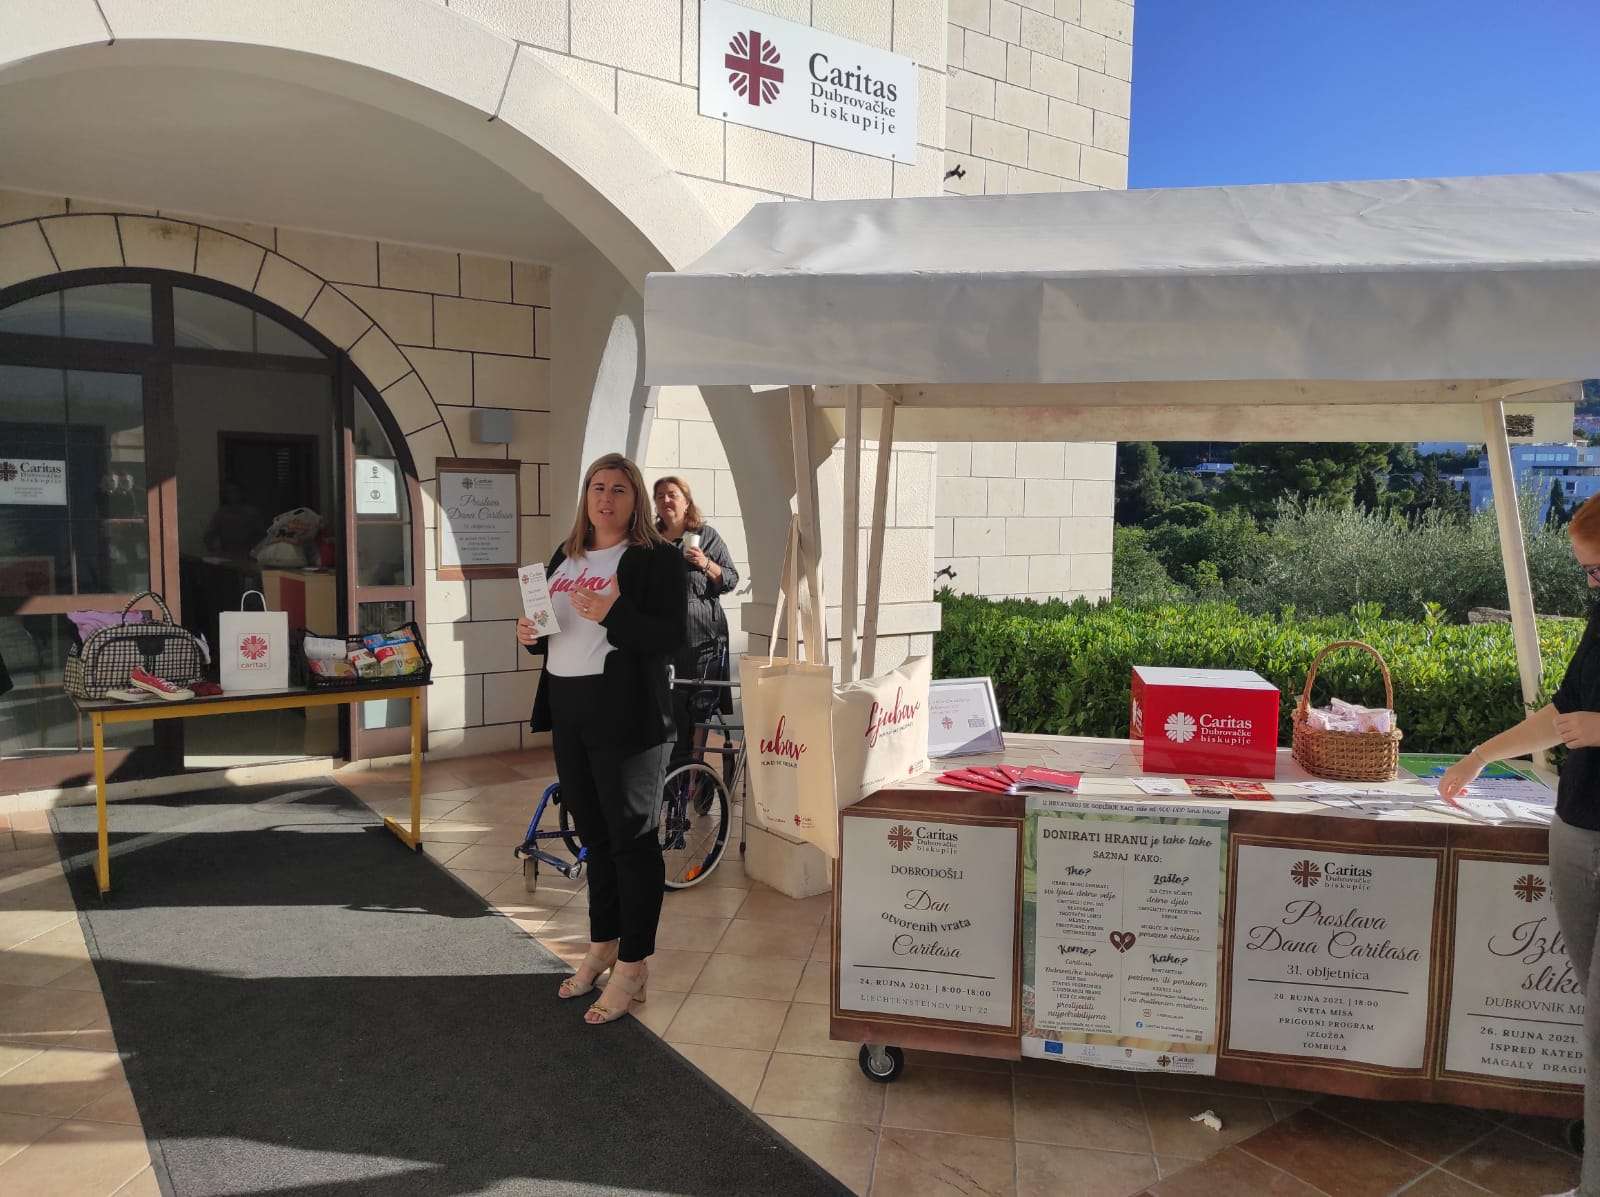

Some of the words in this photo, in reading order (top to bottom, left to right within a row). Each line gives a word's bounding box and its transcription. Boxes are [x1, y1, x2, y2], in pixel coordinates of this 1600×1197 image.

[808, 52, 898, 103] Caritas
[810, 82, 896, 118] Dubrovačke
[810, 99, 896, 135] biskupije
[20, 462, 62, 473] Caritas
[864, 686, 921, 748] Ljubav
[1199, 713, 1252, 729] Caritas
[1201, 727, 1251, 737] Dubrovačke
[1200, 736, 1251, 746] biskupije
[916, 826, 959, 842] Caritas
[1043, 829, 1101, 844] DONIRATI
[1104, 834, 1148, 846] HRANU
[1149, 834, 1160, 849] je
[1093, 850, 1129, 861] SAZNAJ
[1134, 853, 1163, 863] KAKO:
[890, 864, 964, 880] DOBRODOŠLI
[1324, 862, 1373, 878] Caritas
[1153, 873, 1190, 886] Zašto?
[903, 888, 951, 913] Dan
[881, 911, 938, 933] otvorenih
[940, 918, 972, 932] vrata
[1281, 899, 1389, 930] Proslava
[892, 934, 961, 959] Caritasa
[1245, 925, 1320, 953] Dana
[1327, 929, 1422, 962] Caritasa
[1149, 953, 1188, 967] Kako?
[1286, 964, 1302, 977] 31.
[1306, 966, 1370, 981] obljetnica
[859, 977, 872, 986] 24.
[876, 978, 906, 989] RUJNA
[860, 994, 951, 1010] LIECHTENSTEINOV
[955, 1003, 974, 1013] PUT
[1290, 993, 1320, 1004] RUJNA
[1484, 996, 1564, 1014] DUBROVNIK
[1297, 1006, 1326, 1016] SVETA
[1330, 1008, 1354, 1018] MISA
[1279, 1017, 1325, 1028] PRIGODNI
[1328, 1020, 1375, 1031] PROGRAM
[1305, 1030, 1345, 1040] IZLOŽBA
[1479, 1025, 1497, 1036] 26.
[1502, 1028, 1545, 1041] RUJNA
[1302, 1041, 1347, 1052] TOMBULA
[1490, 1042, 1537, 1055] ISPRED
[1541, 1047, 1584, 1059] KATED
[1480, 1056, 1534, 1070] MAGALY
